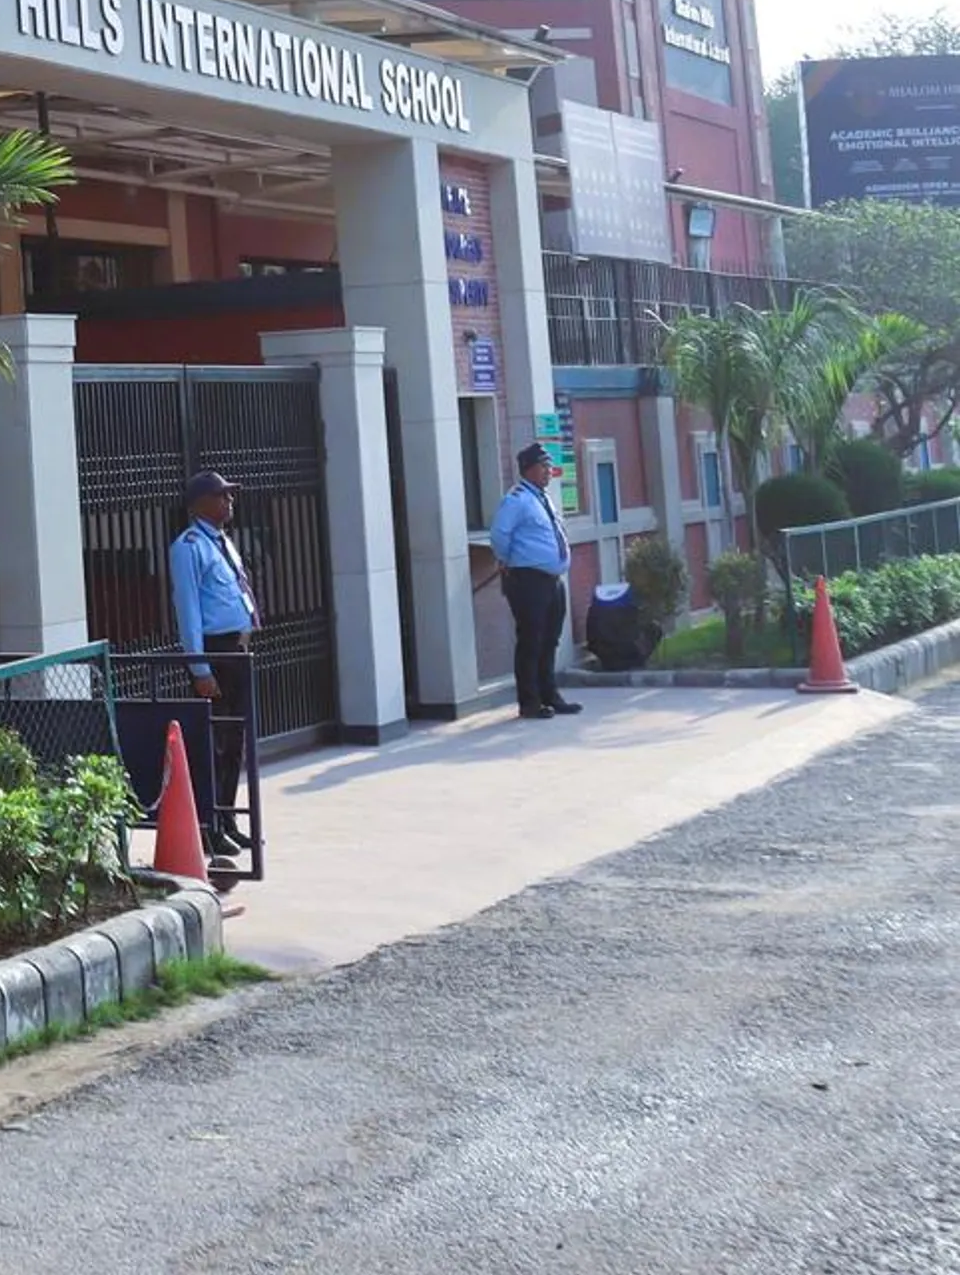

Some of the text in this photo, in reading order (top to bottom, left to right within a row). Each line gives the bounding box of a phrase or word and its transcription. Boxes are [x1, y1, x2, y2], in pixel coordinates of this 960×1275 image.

[380, 58, 471, 133] SCHOOL
[829, 128, 894, 142] ACADEMIC
[837, 138, 909, 152] EMOTIONAL
